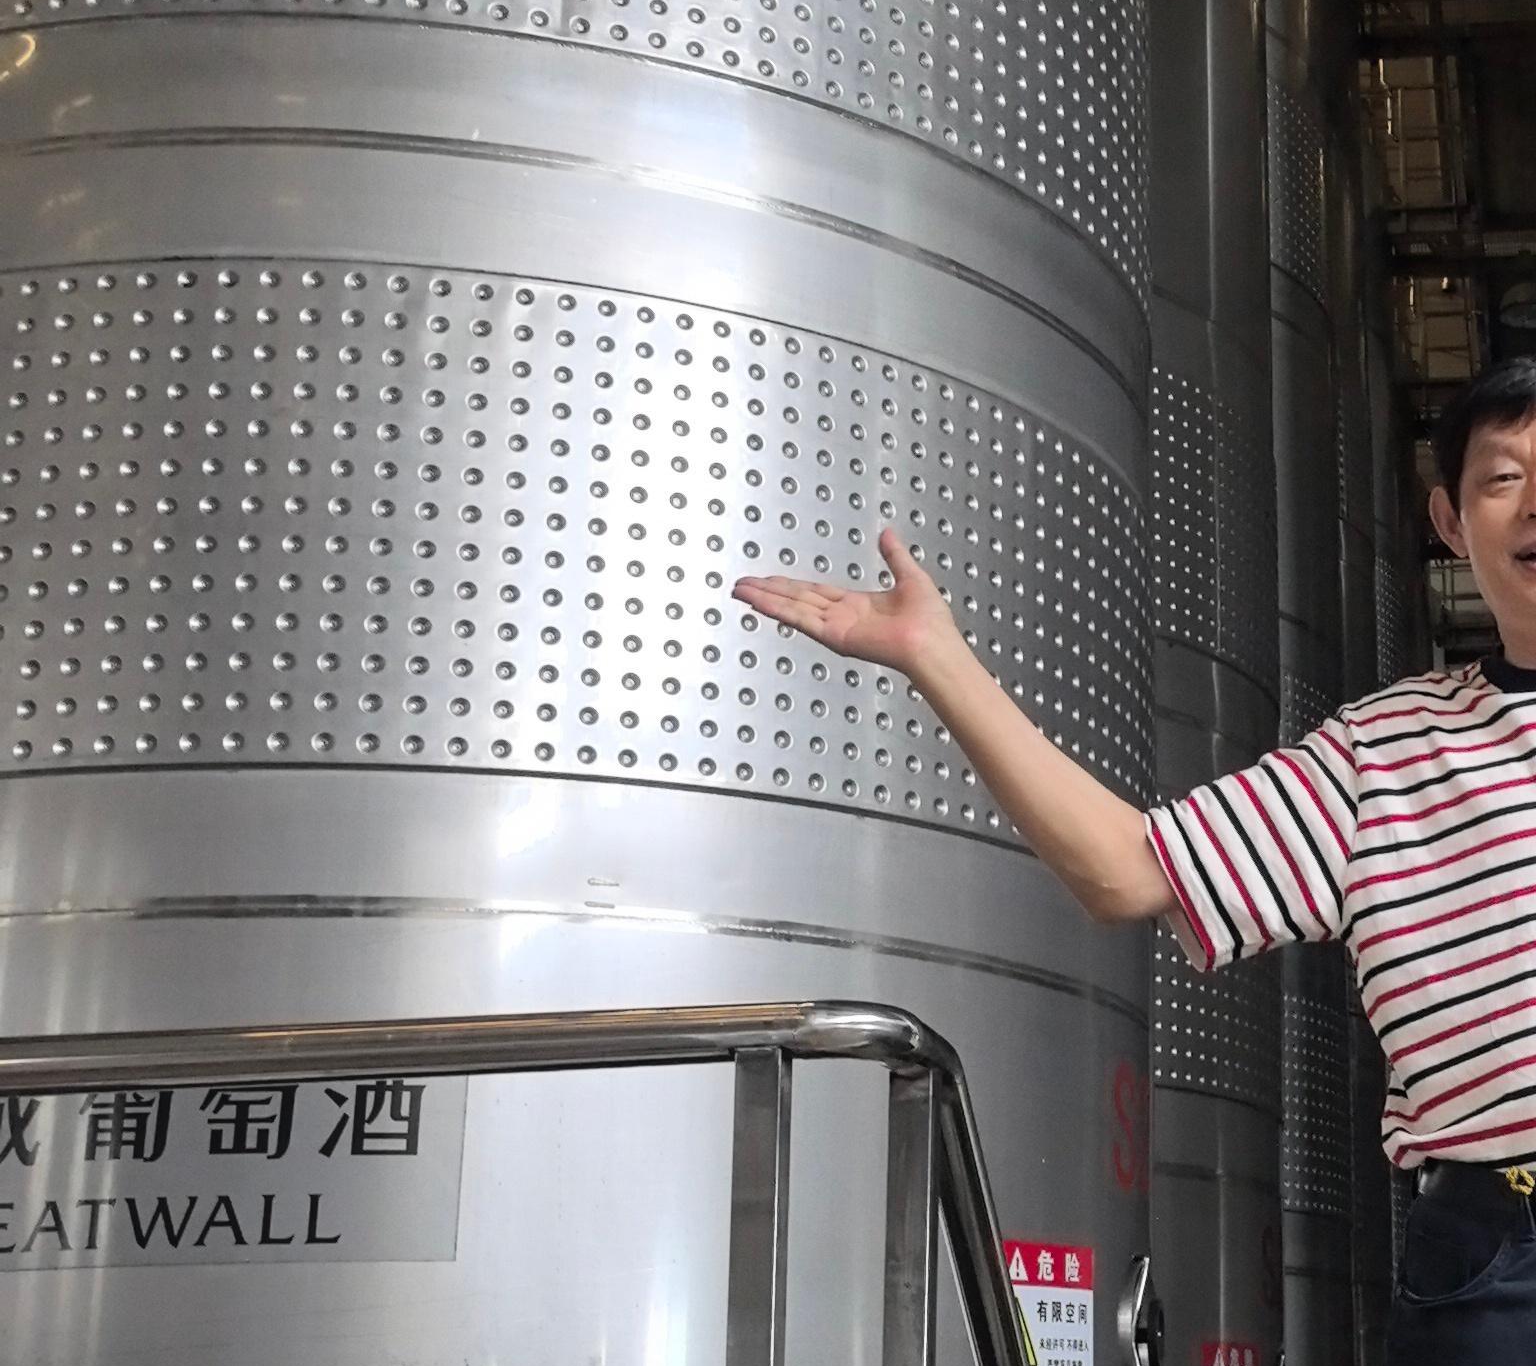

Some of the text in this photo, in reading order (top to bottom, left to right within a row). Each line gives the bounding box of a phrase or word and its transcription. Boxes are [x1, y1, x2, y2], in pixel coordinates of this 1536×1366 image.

[1037, 1250, 1081, 1283] 危险
[1037, 1300, 1088, 1325] 有限空间
